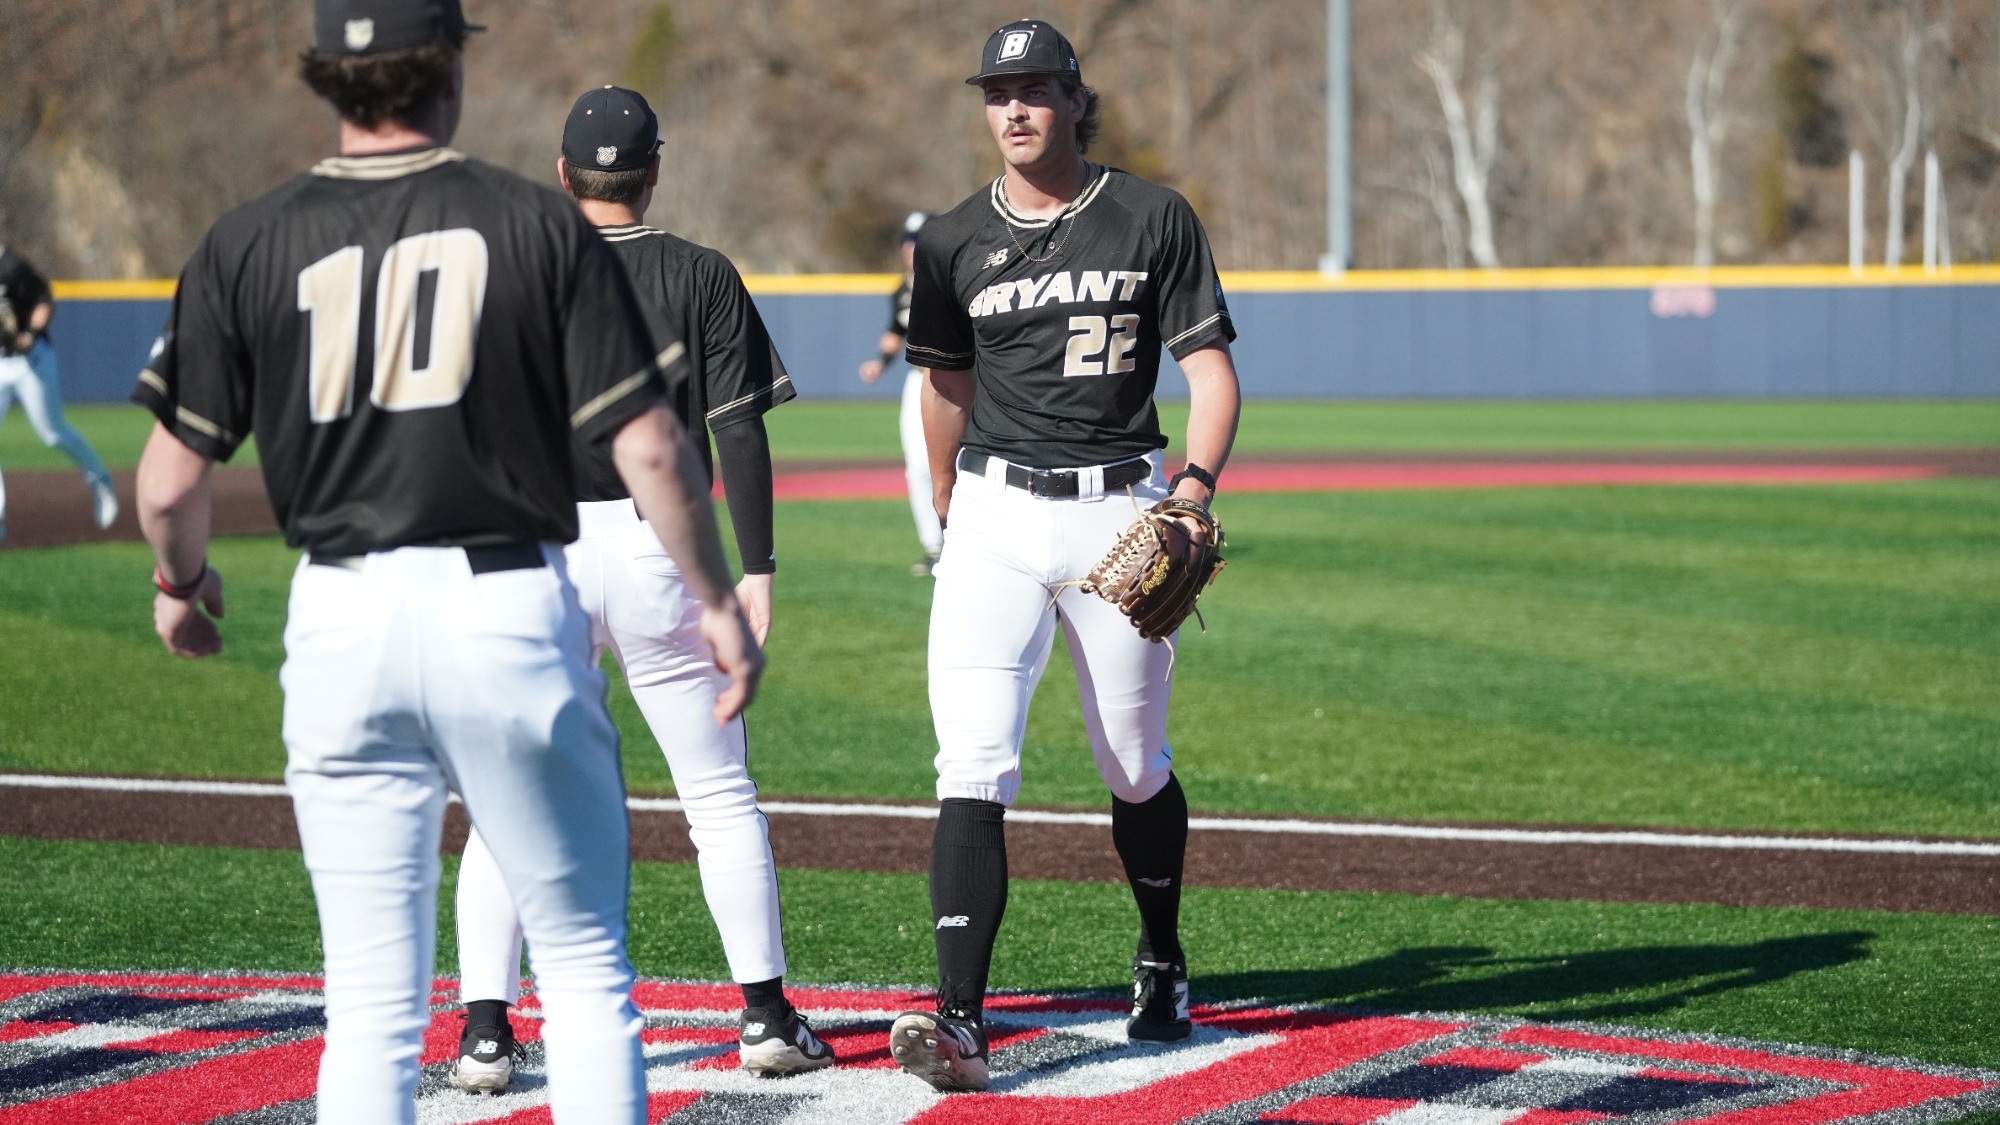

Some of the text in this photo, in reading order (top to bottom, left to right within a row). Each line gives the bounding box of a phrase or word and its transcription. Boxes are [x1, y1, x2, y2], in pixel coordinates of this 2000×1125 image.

[1000, 33, 1029, 59] B
[968, 270, 1148, 318] BRYANT
[297, 231, 489, 423] 10
[1063, 313, 1140, 377] 22
[473, 1040, 498, 1054] NB
[742, 1022, 765, 1036] NB
